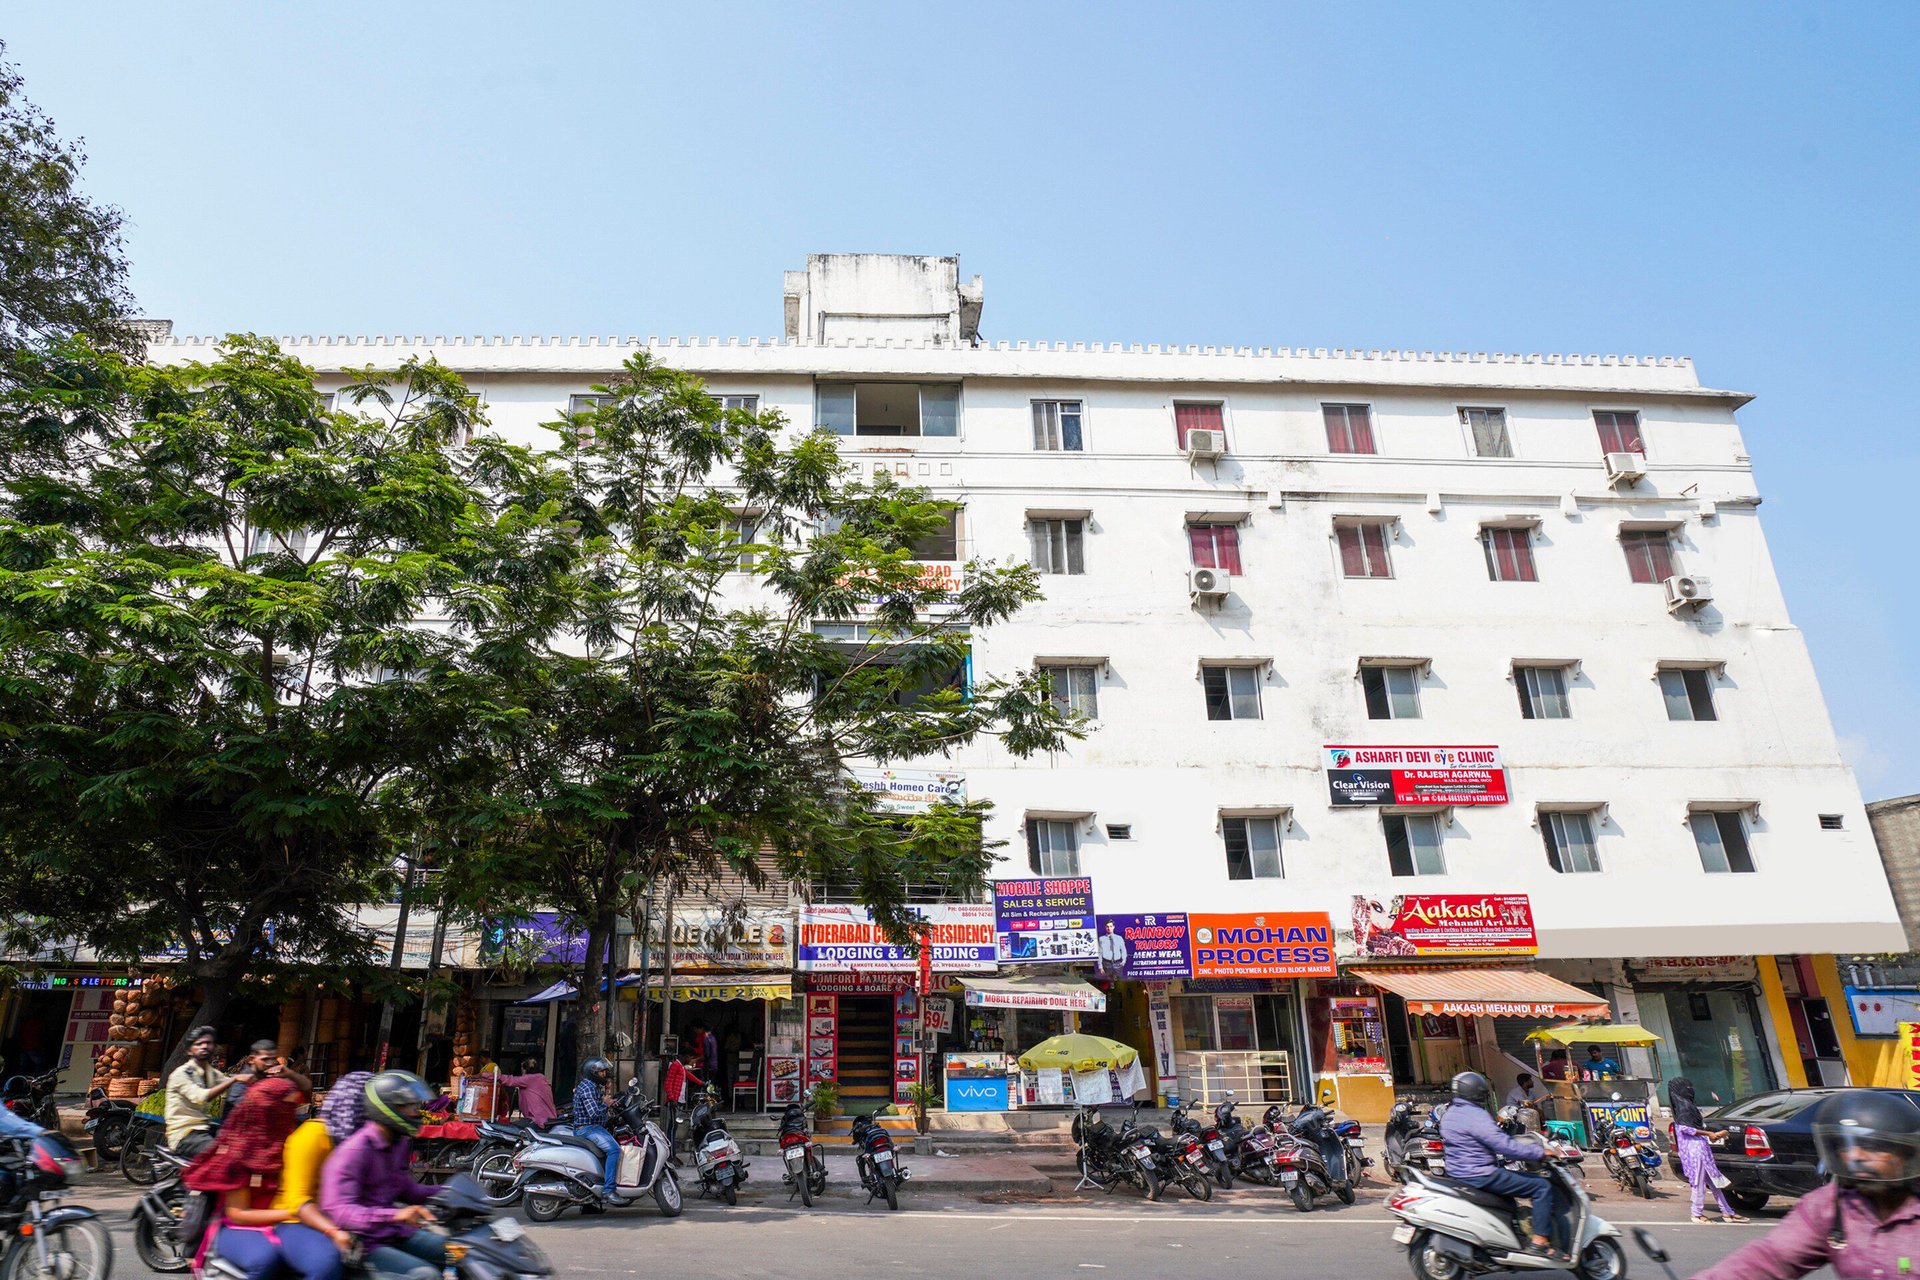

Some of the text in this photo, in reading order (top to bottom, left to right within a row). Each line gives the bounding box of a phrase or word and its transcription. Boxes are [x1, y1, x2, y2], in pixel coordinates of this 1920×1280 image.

[1356, 751, 1404, 763] ASHARFI
[1406, 751, 1432, 763] DEVI
[1458, 751, 1495, 763] CLINIC
[890, 782, 924, 792] Homeo
[927, 784, 952, 794] Care
[1332, 781, 1390, 789] Clear Vision
[996, 880, 1090, 897] MOBILE SHOPPE
[1046, 898, 1085, 906] SERVICE
[1402, 898, 1497, 925] Aakash
[769, 924, 784, 943] 2
[802, 924, 870, 944] HYDERABAD
[932, 924, 994, 944] RESIDENCY
[1125, 926, 1185, 940] RAINBOW
[1217, 927, 1327, 944] MOHAN
[1135, 940, 1178, 950] TAILORS
[817, 947, 883, 960] LODGING
[888, 948, 898, 960] &
[1197, 947, 1330, 965] PROCESS
[811, 974, 856, 983] COMFORT
[690, 988, 727, 998] NILE
[736, 988, 745, 997] 2
[985, 995, 1086, 1008] MOBILE REPAIRING DONE HERE
[1443, 1003, 1555, 1014] AAKASH MEHANDI ART
[958, 1085, 997, 1097] vivo
[1591, 1108, 1647, 1122] TEA POINT
